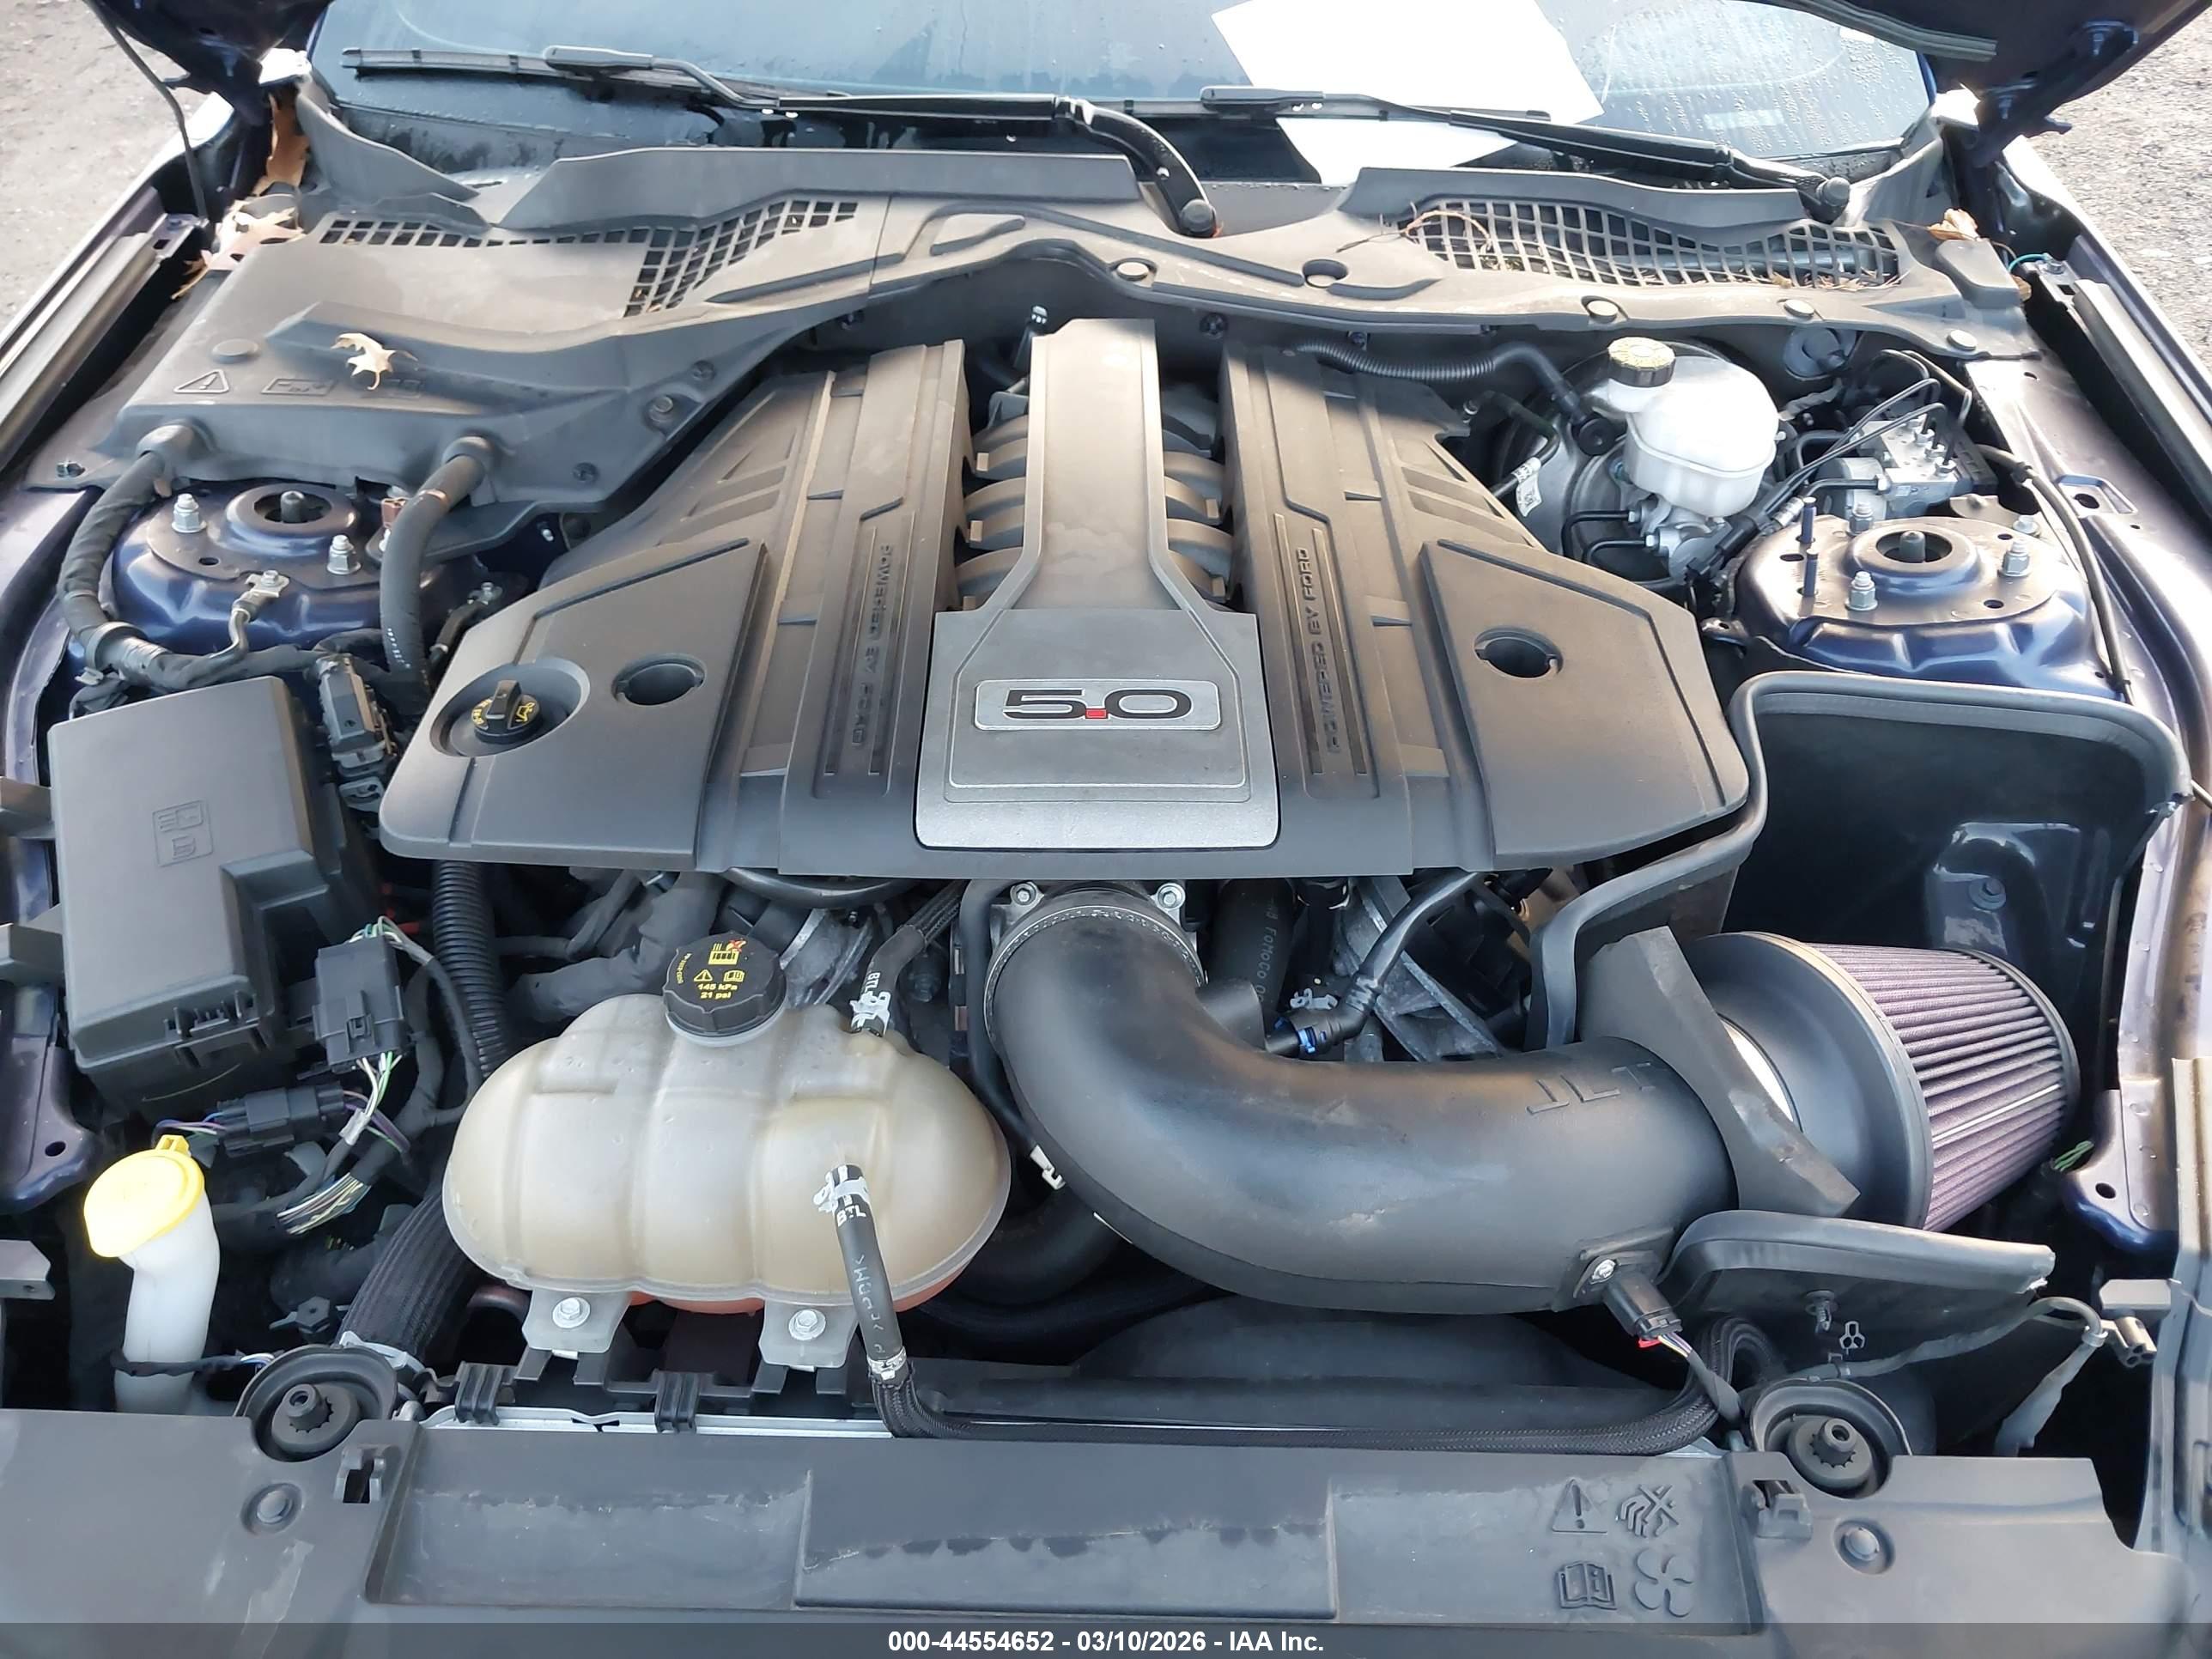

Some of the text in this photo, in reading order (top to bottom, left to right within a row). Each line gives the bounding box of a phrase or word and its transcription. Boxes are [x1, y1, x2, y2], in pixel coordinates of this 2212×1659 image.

[1296, 547, 1340, 754] POWERED BY FORD
[1002, 687, 1194, 720] 5.0
[714, 992, 732, 1000] psi
[1526, 1061, 1656, 1115] JLT
